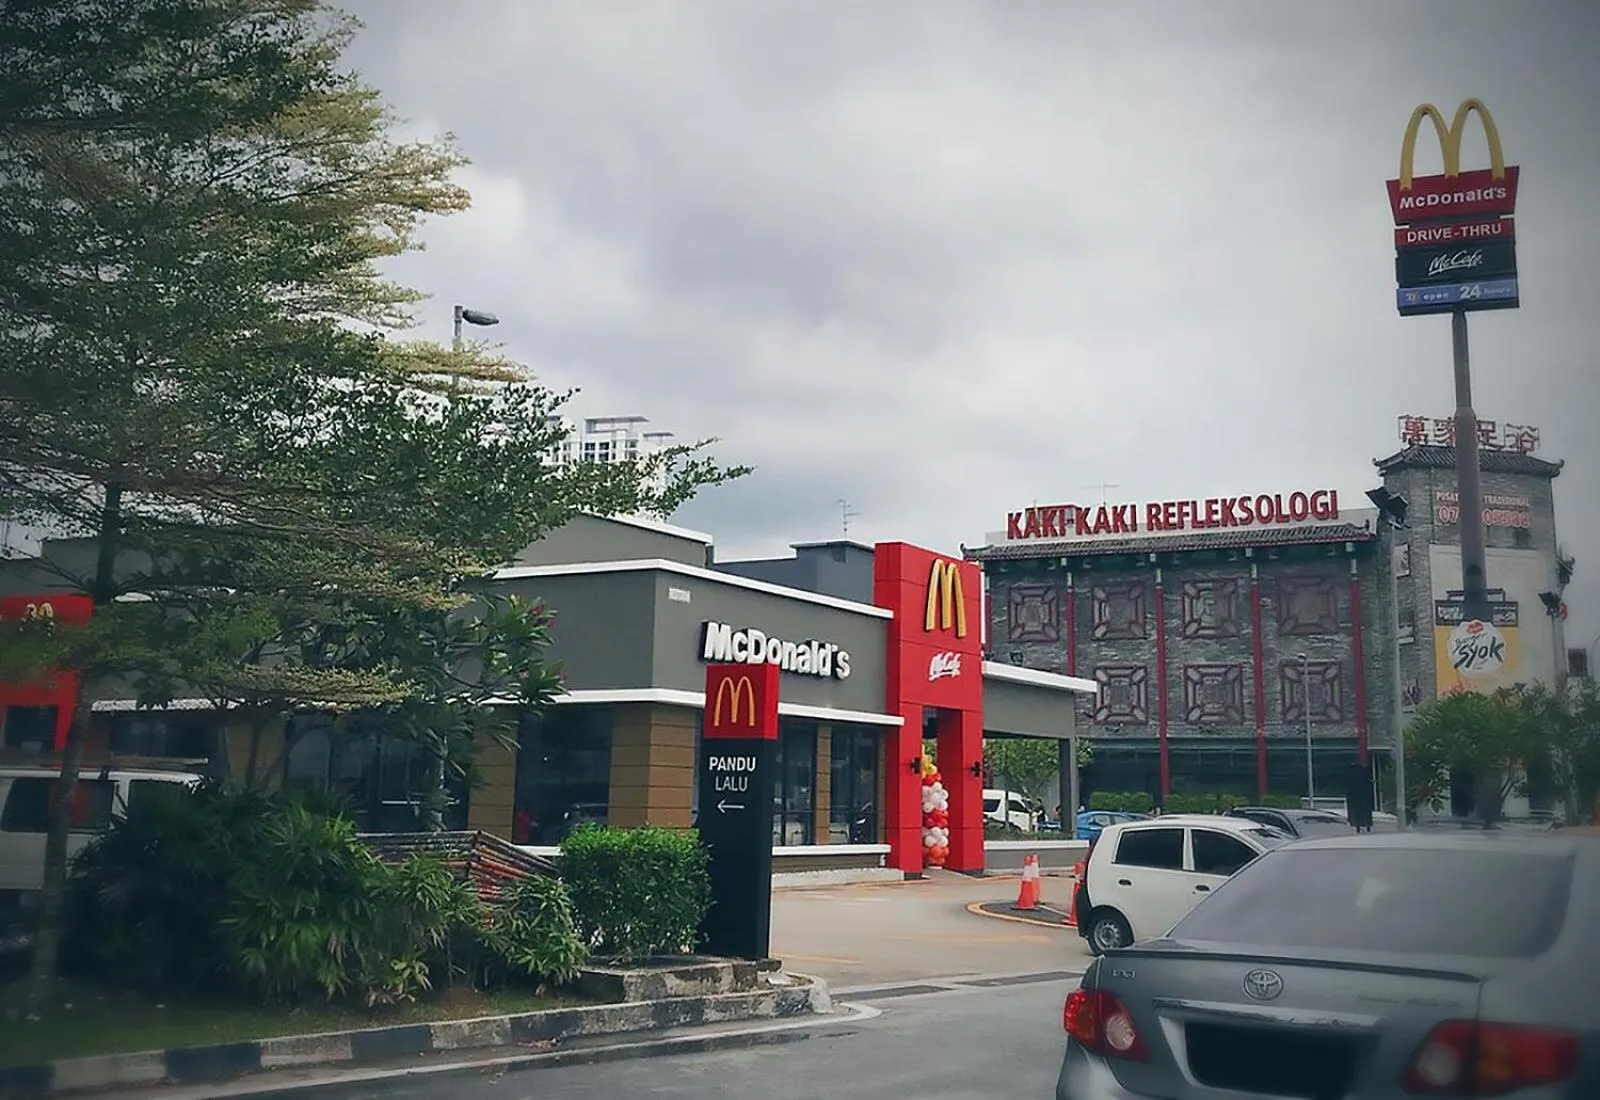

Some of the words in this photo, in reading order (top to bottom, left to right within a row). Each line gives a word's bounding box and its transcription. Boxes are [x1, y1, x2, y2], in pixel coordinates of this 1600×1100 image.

[1400, 187, 1506, 209] McDonald's
[1407, 223, 1502, 242] DRIVE-THRU
[1460, 284, 1482, 300] 24
[1007, 508, 1067, 540] KAKI
[1075, 504, 1138, 536] KAKI
[1146, 490, 1339, 532] REFLEKSOLOGI
[701, 621, 851, 680] McDonald's
[709, 756, 756, 772] PANDU
[715, 776, 748, 791] LALU
